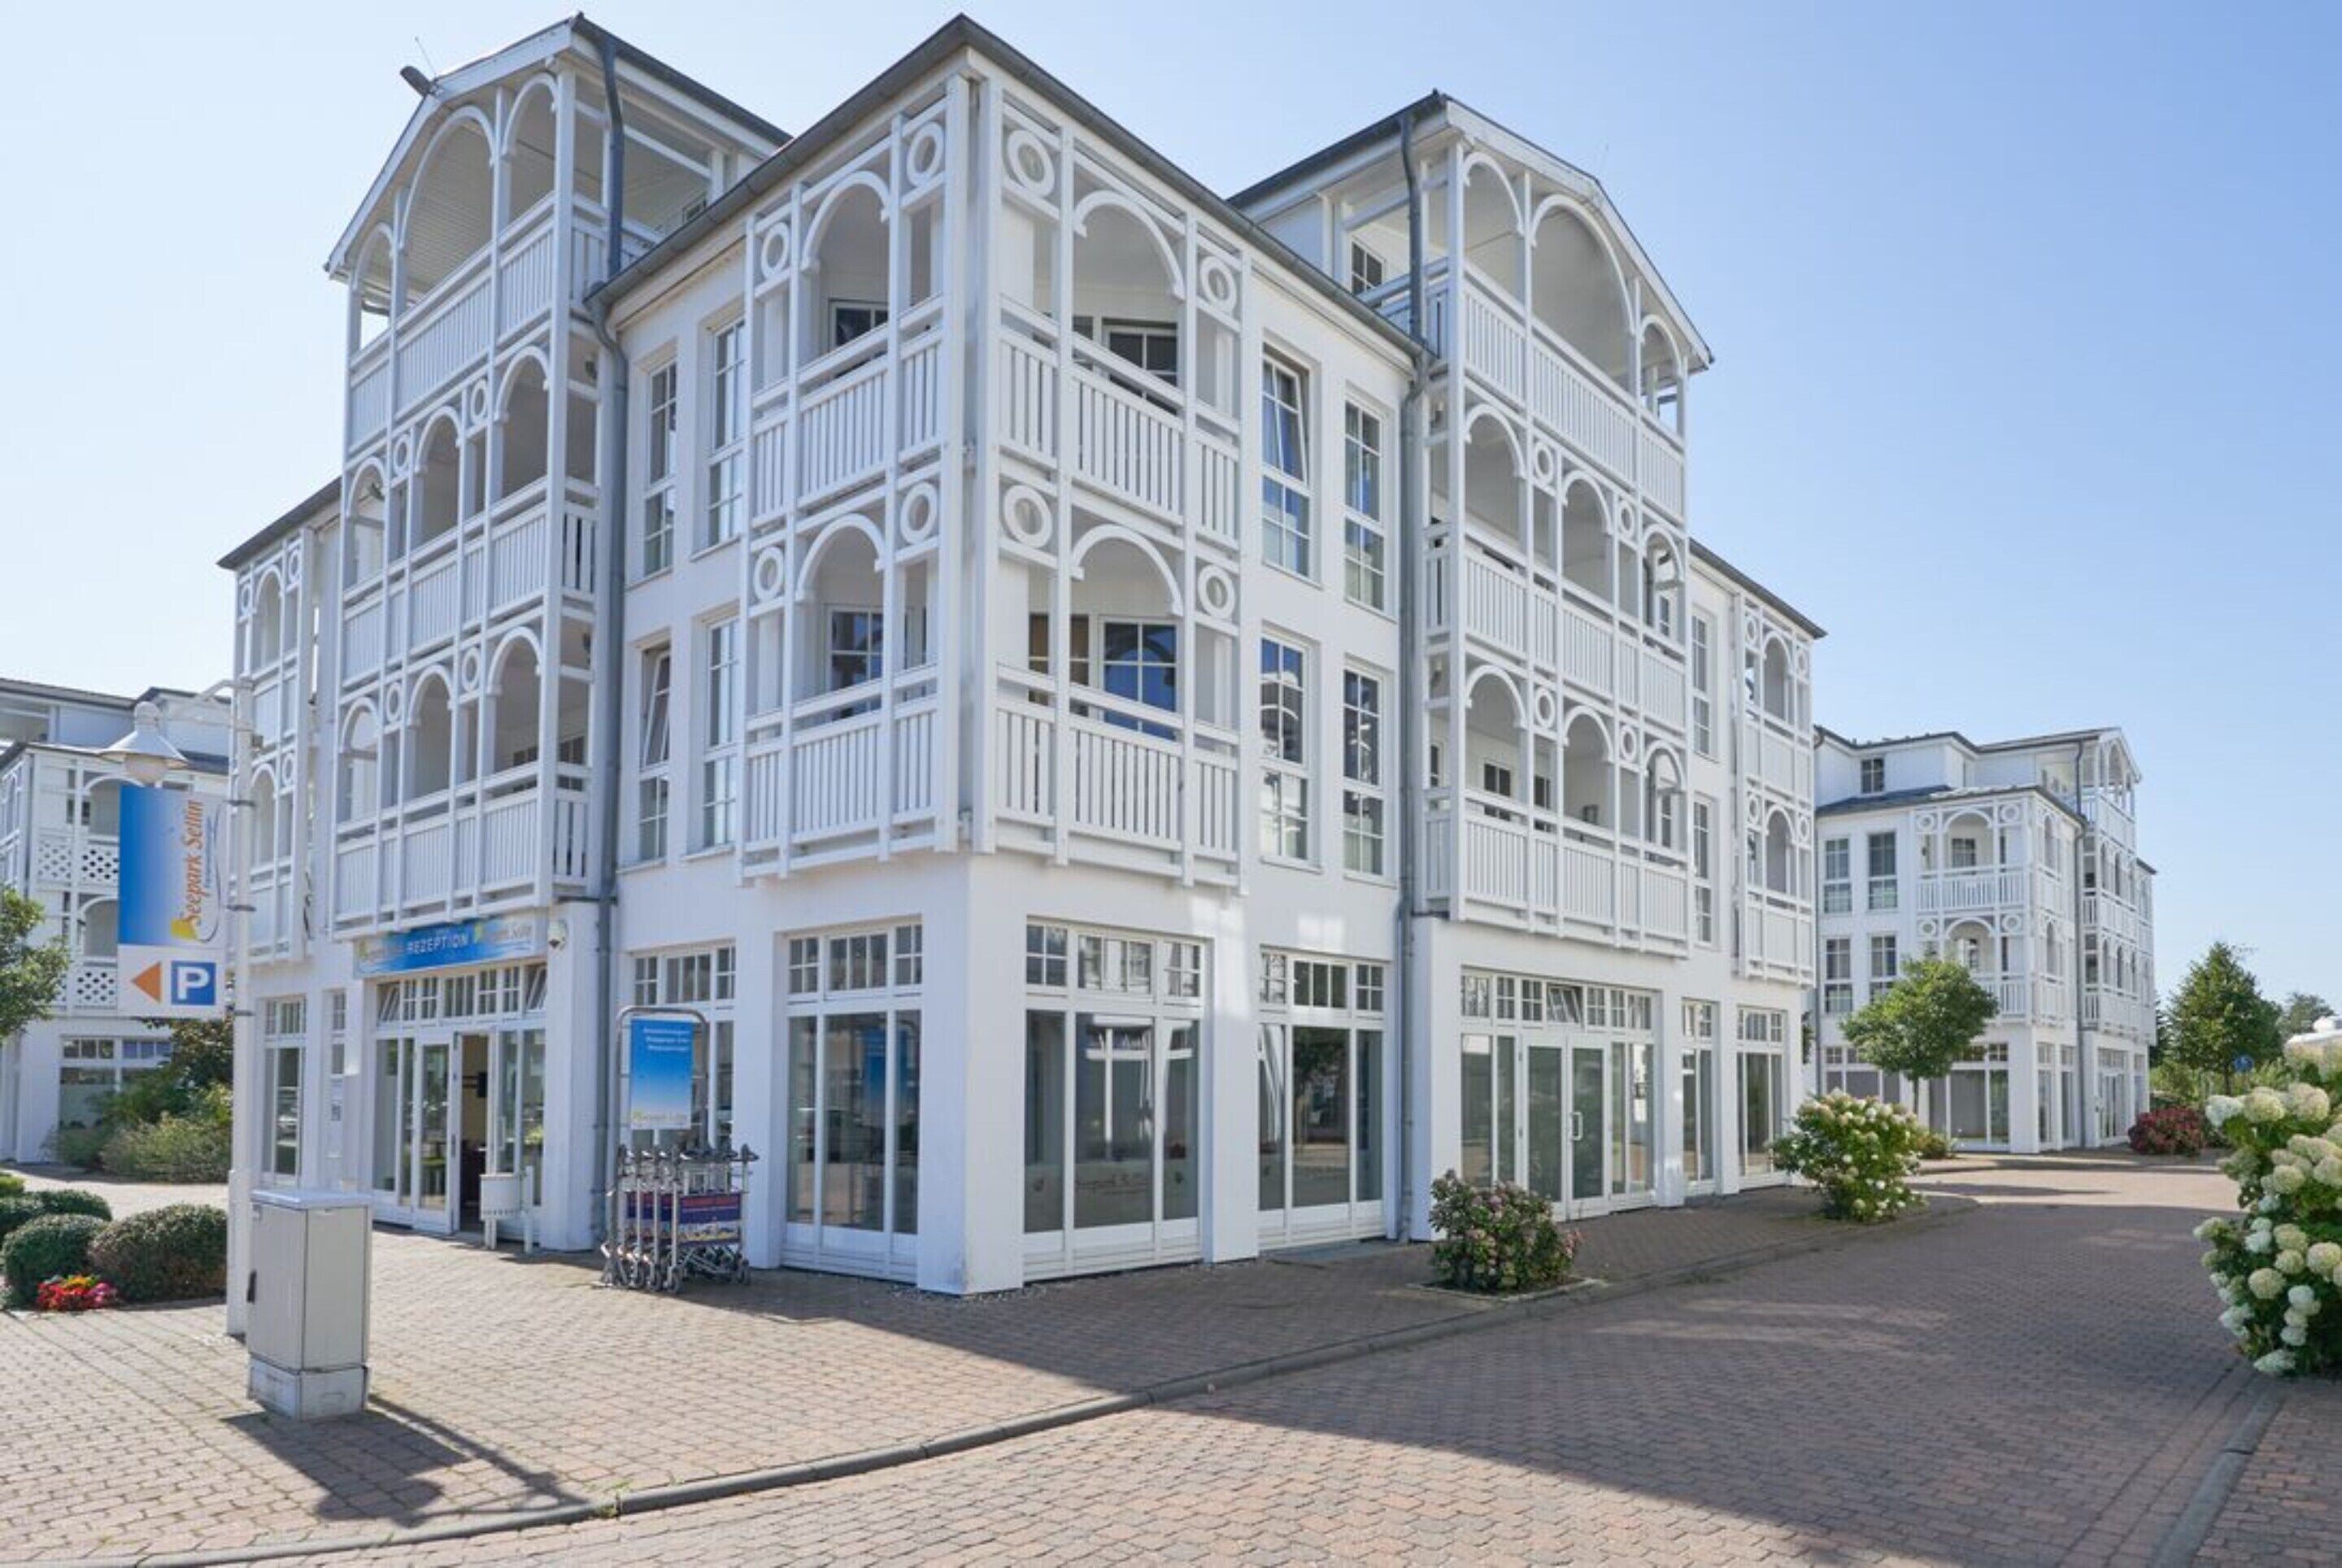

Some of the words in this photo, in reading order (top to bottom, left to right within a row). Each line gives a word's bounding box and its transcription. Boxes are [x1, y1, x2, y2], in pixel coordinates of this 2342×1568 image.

[181, 799, 204, 850] Sellin
[180, 854, 210, 926] Seepark
[407, 934, 469, 955] REZEPTION
[177, 966, 209, 1000] P
